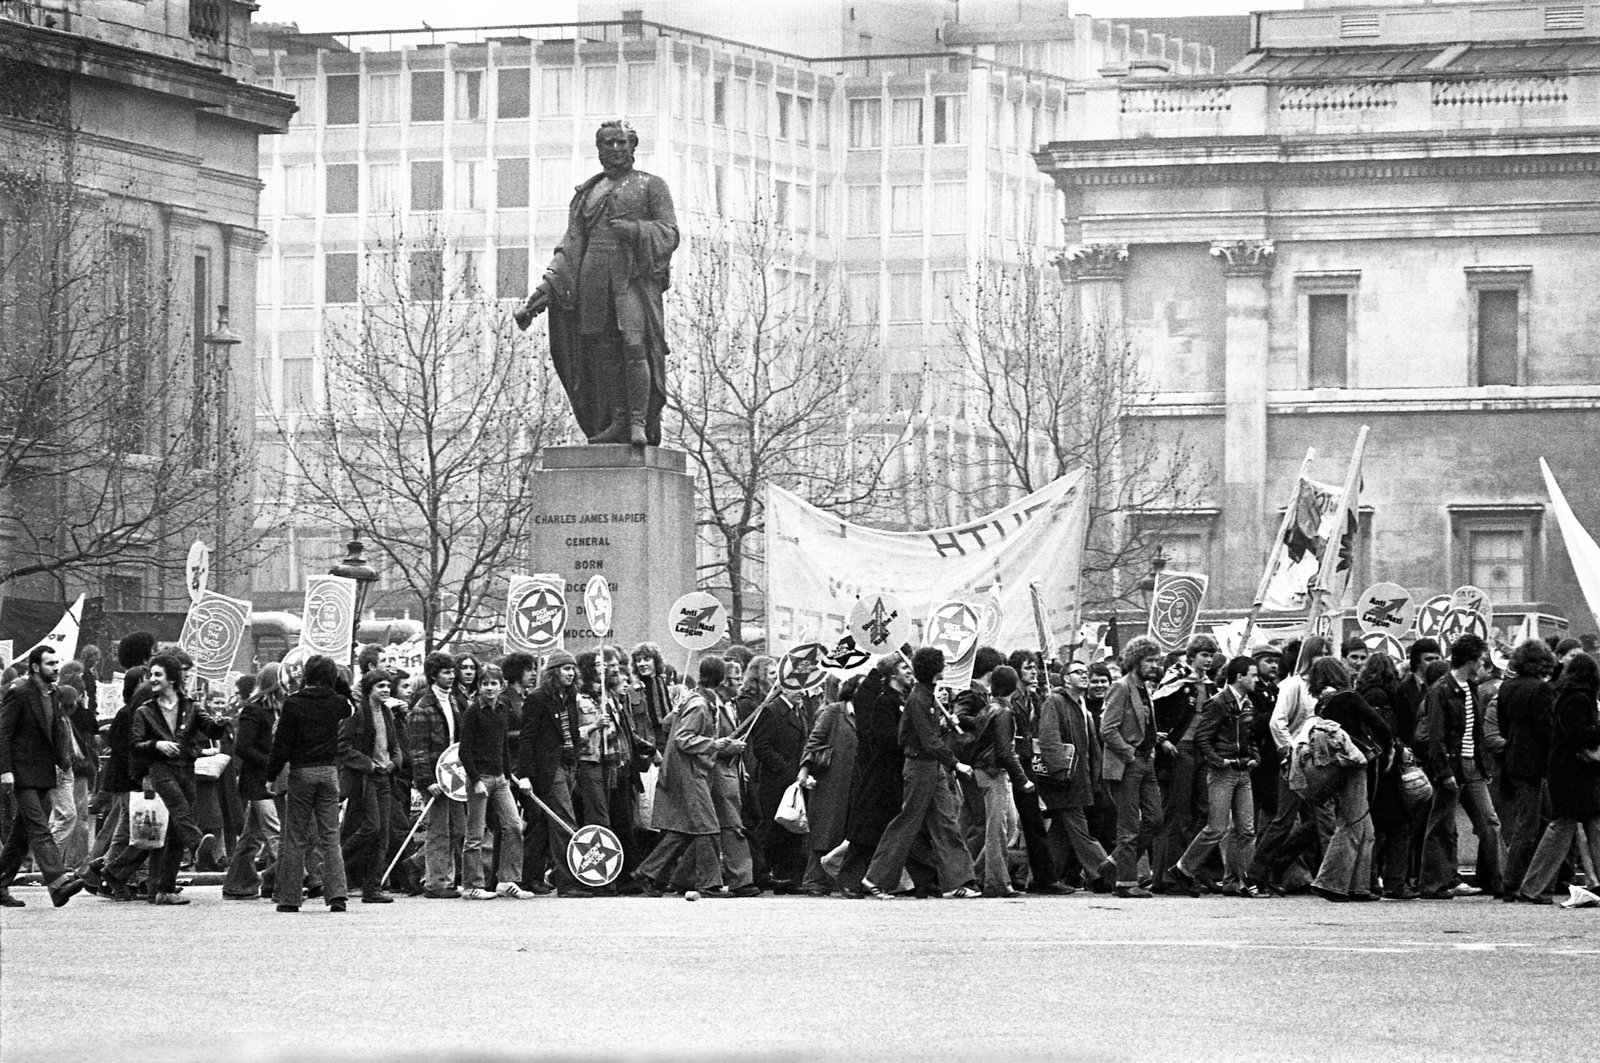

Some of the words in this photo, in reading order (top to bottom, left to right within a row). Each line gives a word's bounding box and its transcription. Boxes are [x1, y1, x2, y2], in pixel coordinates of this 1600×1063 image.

[535, 514, 577, 524] CHARLES
[579, 514, 609, 524] JAMES
[612, 513, 646, 523] NAPIER
[565, 537, 610, 547] GENERAL
[575, 560, 603, 570] BORN
[1369, 597, 1387, 607] Anti
[680, 607, 698, 616] Anti
[881, 617, 892, 627] the
[1362, 613, 1390, 628] League
[1386, 614, 1403, 625] Nazi
[699, 622, 715, 632] Nazi
[862, 619, 877, 631] Stop
[675, 625, 703, 637] League
